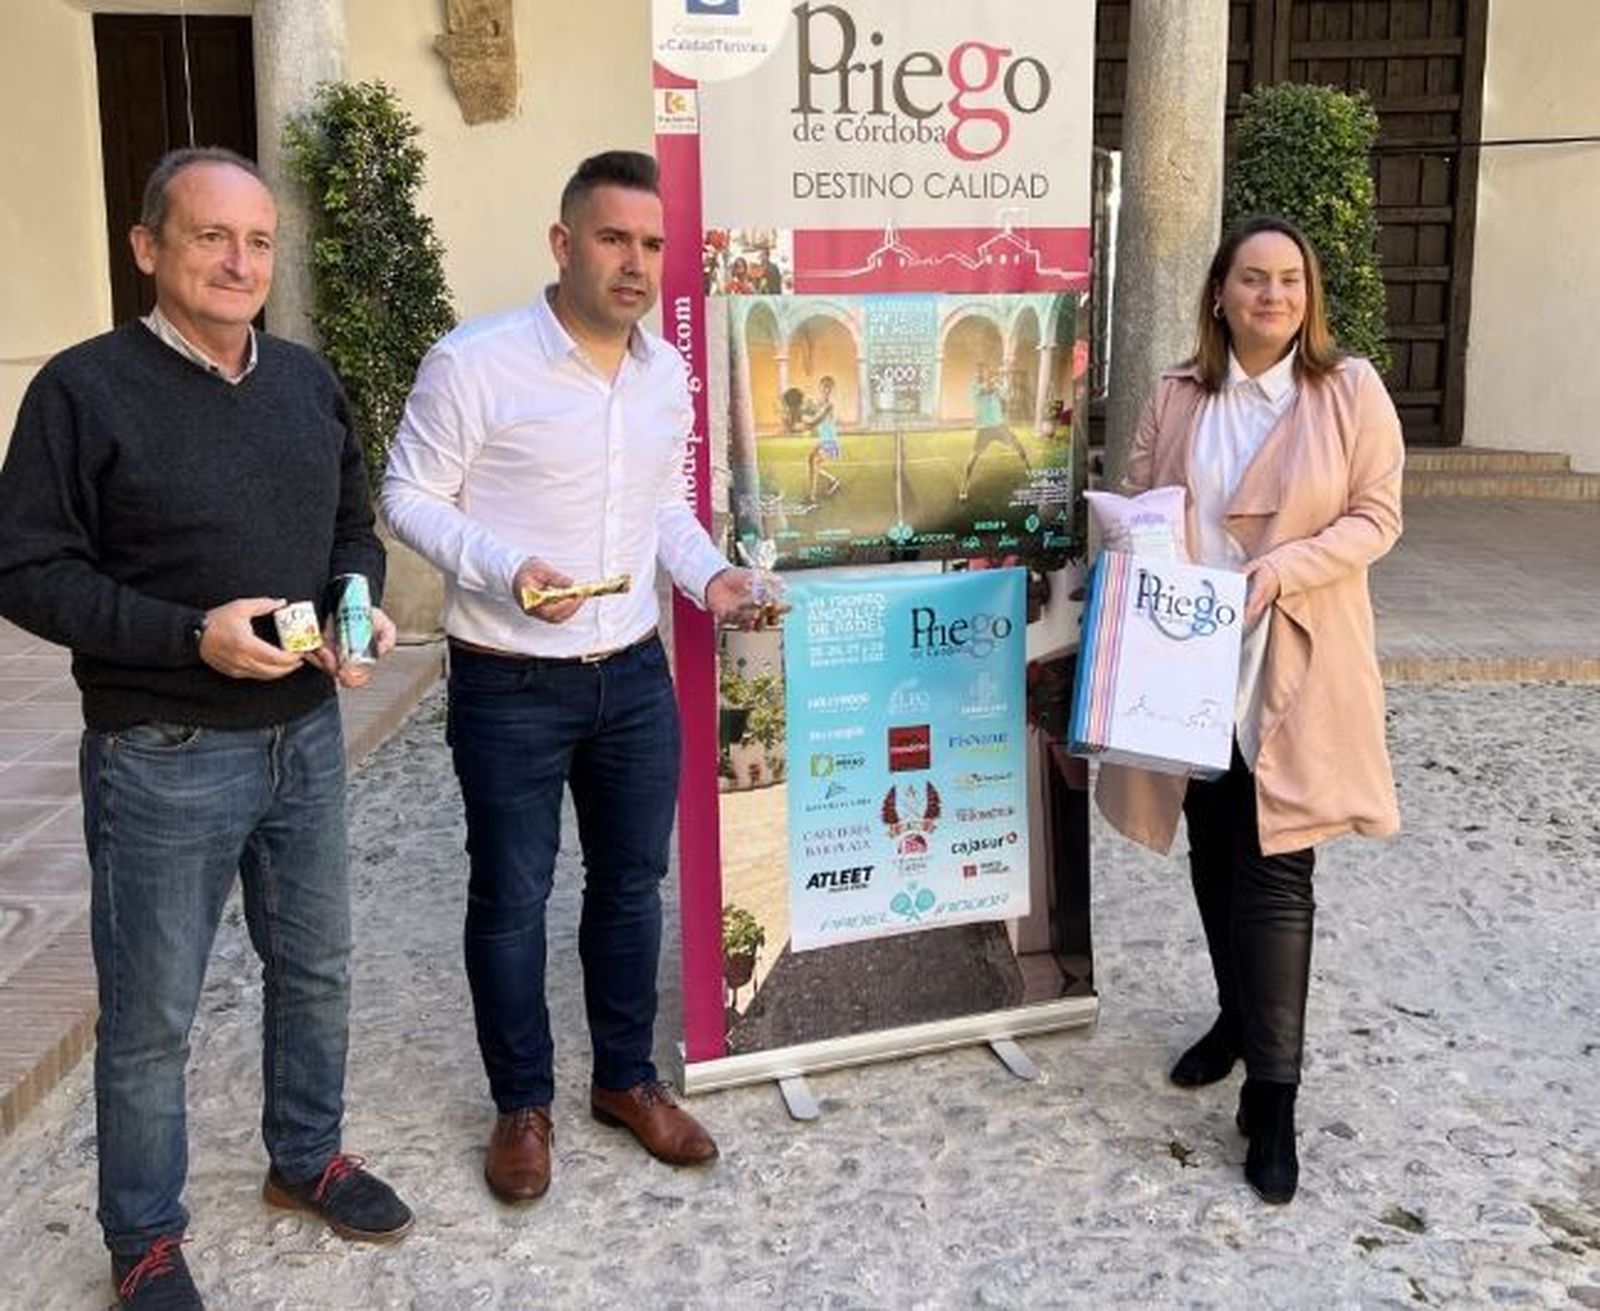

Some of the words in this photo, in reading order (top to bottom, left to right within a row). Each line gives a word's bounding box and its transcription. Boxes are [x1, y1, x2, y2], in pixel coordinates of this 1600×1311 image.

[790, 3, 1051, 161] Priego
[793, 119, 825, 143] de
[835, 117, 946, 144] Córdoba
[793, 172, 912, 199] DESTINO
[924, 172, 1050, 199] CALIDAD
[1137, 571, 1236, 636] Priego
[910, 607, 1012, 658] Priego
[951, 836, 1003, 856] cajasur
[805, 865, 875, 891] ATLEET
